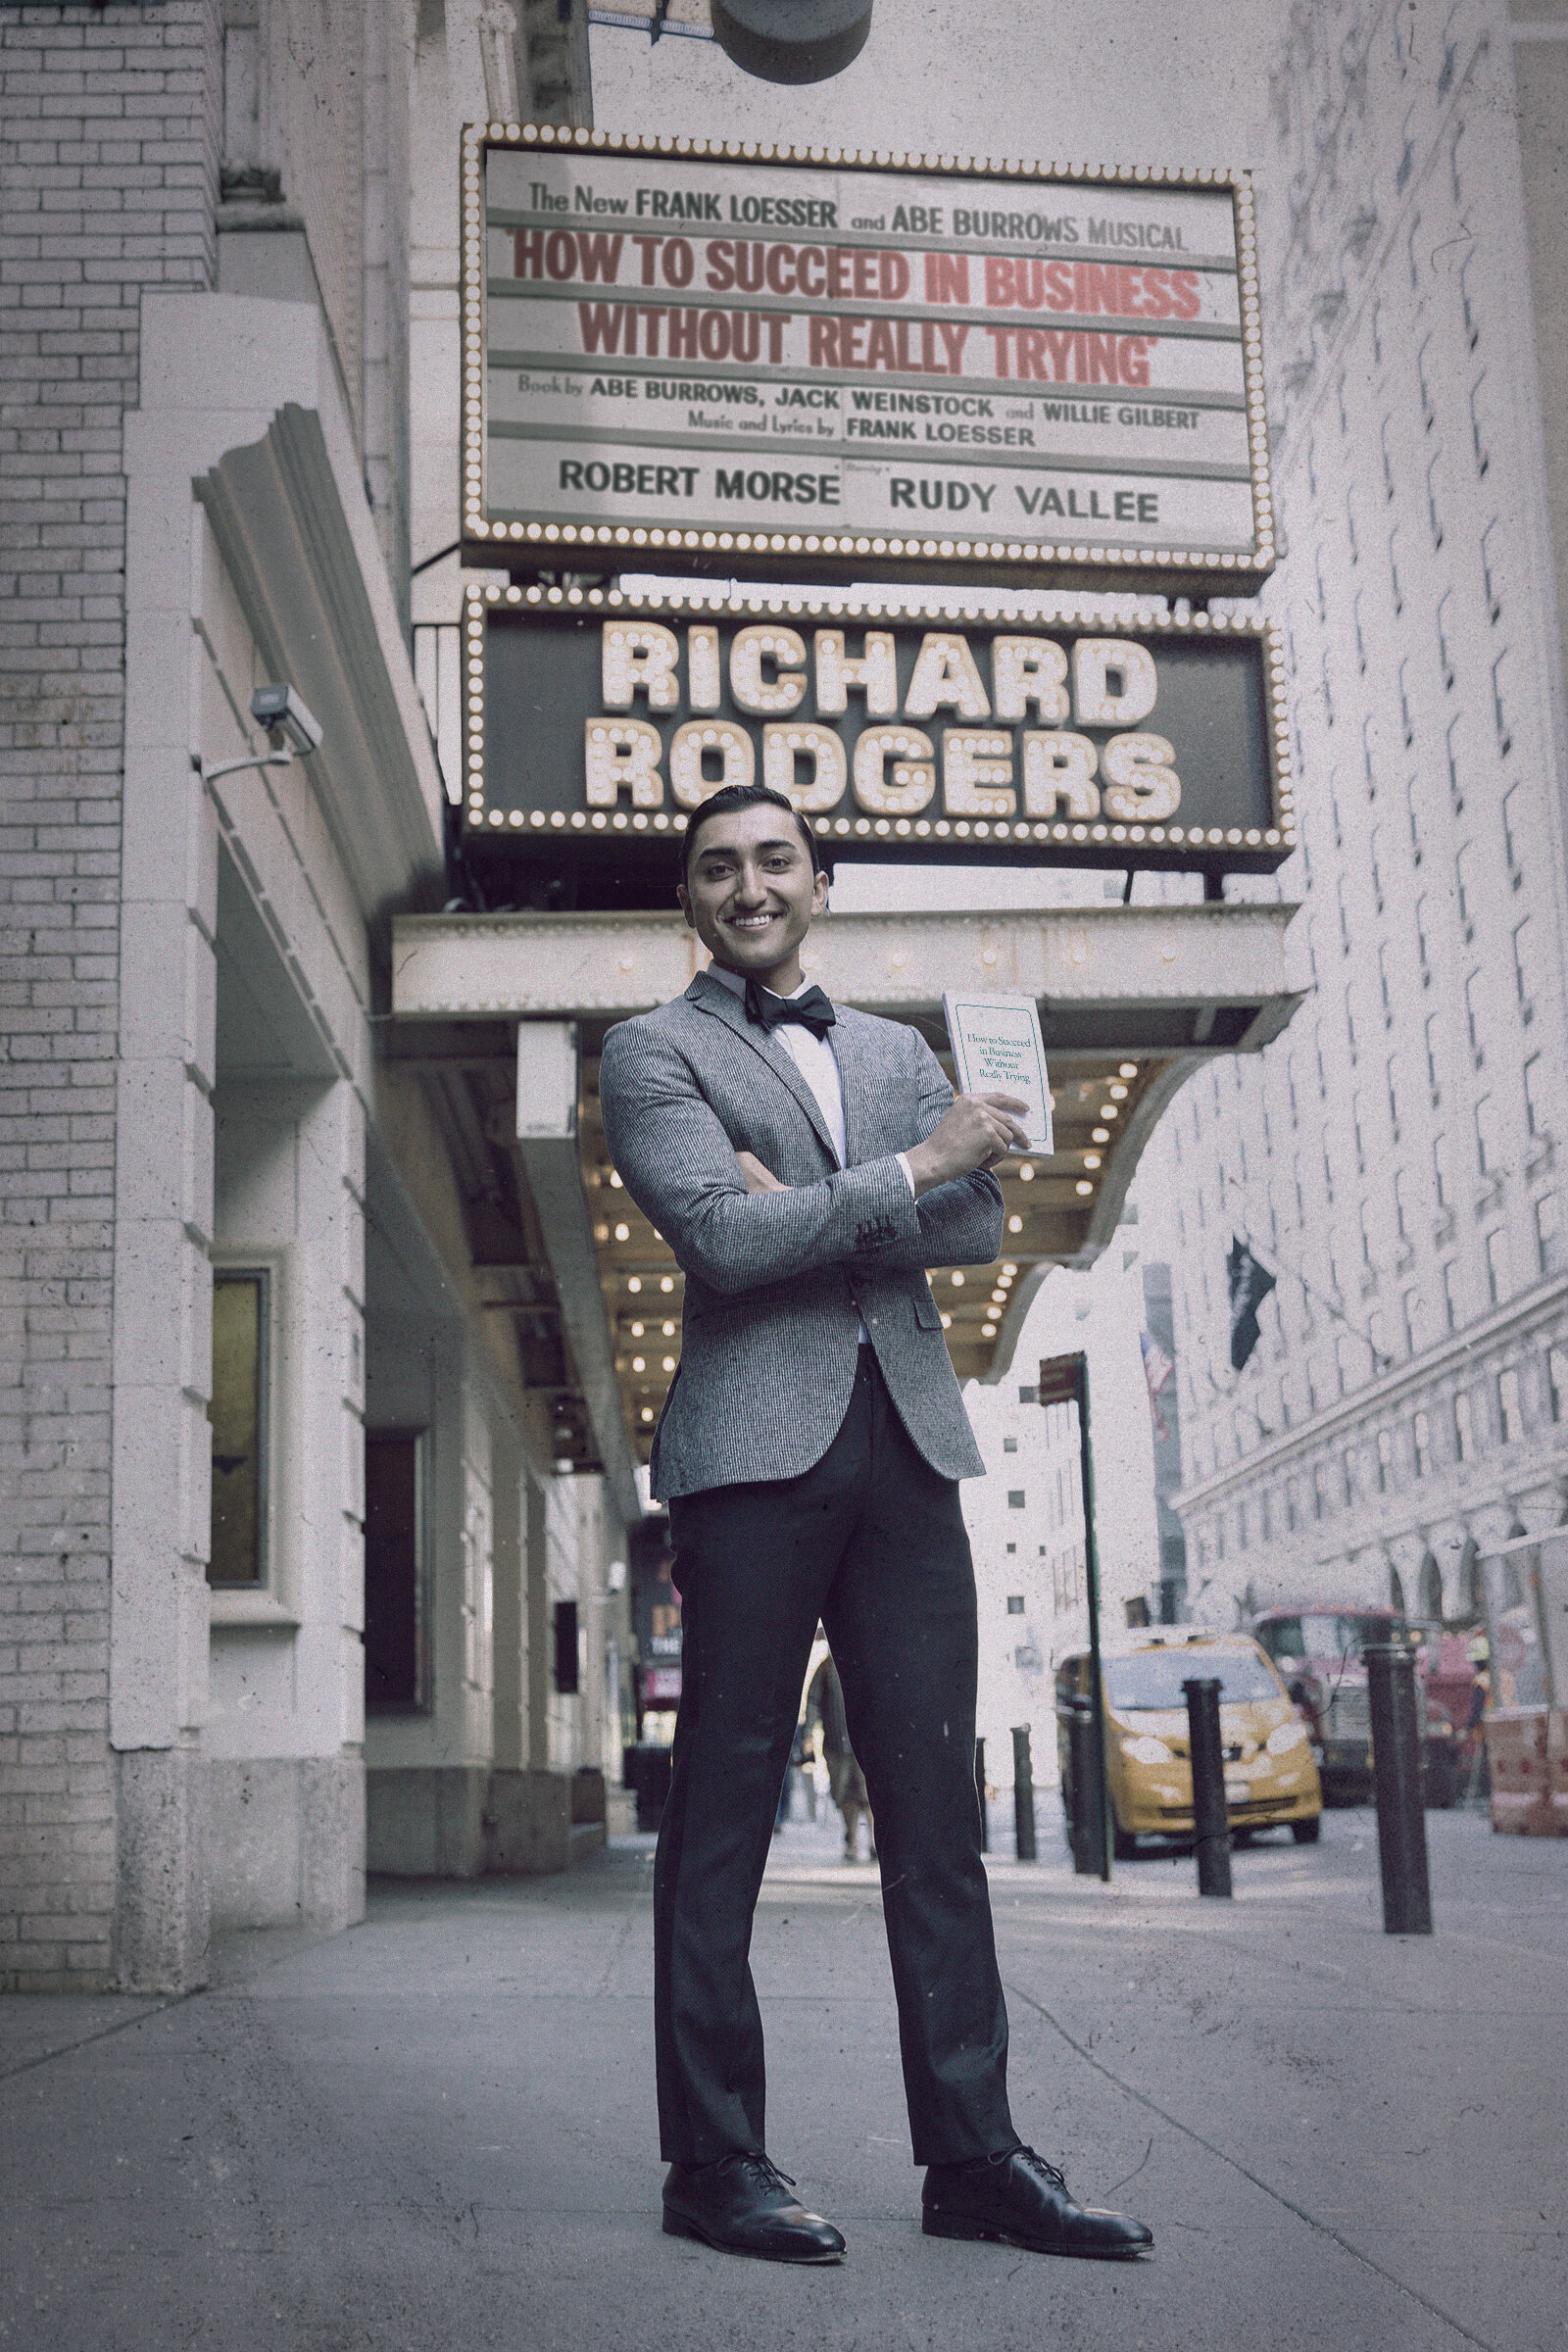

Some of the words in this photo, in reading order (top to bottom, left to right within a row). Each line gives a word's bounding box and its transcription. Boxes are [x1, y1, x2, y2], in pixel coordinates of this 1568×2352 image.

[529, 182, 569, 212] The
[575, 185, 628, 214] New
[636, 189, 722, 220] FRANK
[730, 195, 838, 228] LOESSER
[852, 214, 885, 231] and
[892, 205, 944, 234] ABE
[954, 209, 1078, 243] BURROWS
[1088, 217, 1188, 251] MUSICAL
[632, 235, 695, 288] TO
[706, 239, 910, 301] SUCCEED
[924, 252, 970, 305] IN
[984, 256, 1200, 320] BUSINESS
[578, 302, 791, 365] WITHOUT
[808, 315, 971, 376] REALLY
[517, 374, 562, 394] Book
[564, 377, 584, 398] by
[590, 377, 639, 399] ABE
[645, 380, 765, 407] BURROWS,
[774, 387, 840, 410] JACK
[852, 390, 994, 418] WEINSTOCK
[1005, 401, 1034, 421] and
[1043, 402, 1111, 425] WILLIE
[1117, 406, 1200, 430] GILBERT
[688, 410, 734, 431] Music
[738, 413, 768, 433] and
[771, 415, 814, 438] Lyrics
[817, 417, 836, 438] by
[846, 417, 917, 441] FRANK
[925, 422, 1037, 448] LOESSER
[560, 460, 701, 497] ROBERT
[715, 468, 841, 507] MORSE
[890, 477, 997, 514] RUDY
[1015, 485, 1159, 524] VALLEE
[601, 620, 1158, 727] RICHARD
[584, 717, 1183, 823] RODGERS
[967, 1033, 988, 1044] How
[998, 1036, 1031, 1048] Succeed
[979, 1046, 988, 1055] in
[988, 1047, 1022, 1058] Business
[983, 1057, 1019, 1069] Without
[979, 1068, 1003, 1082] Really
[1003, 1070, 1032, 1085] Trying
